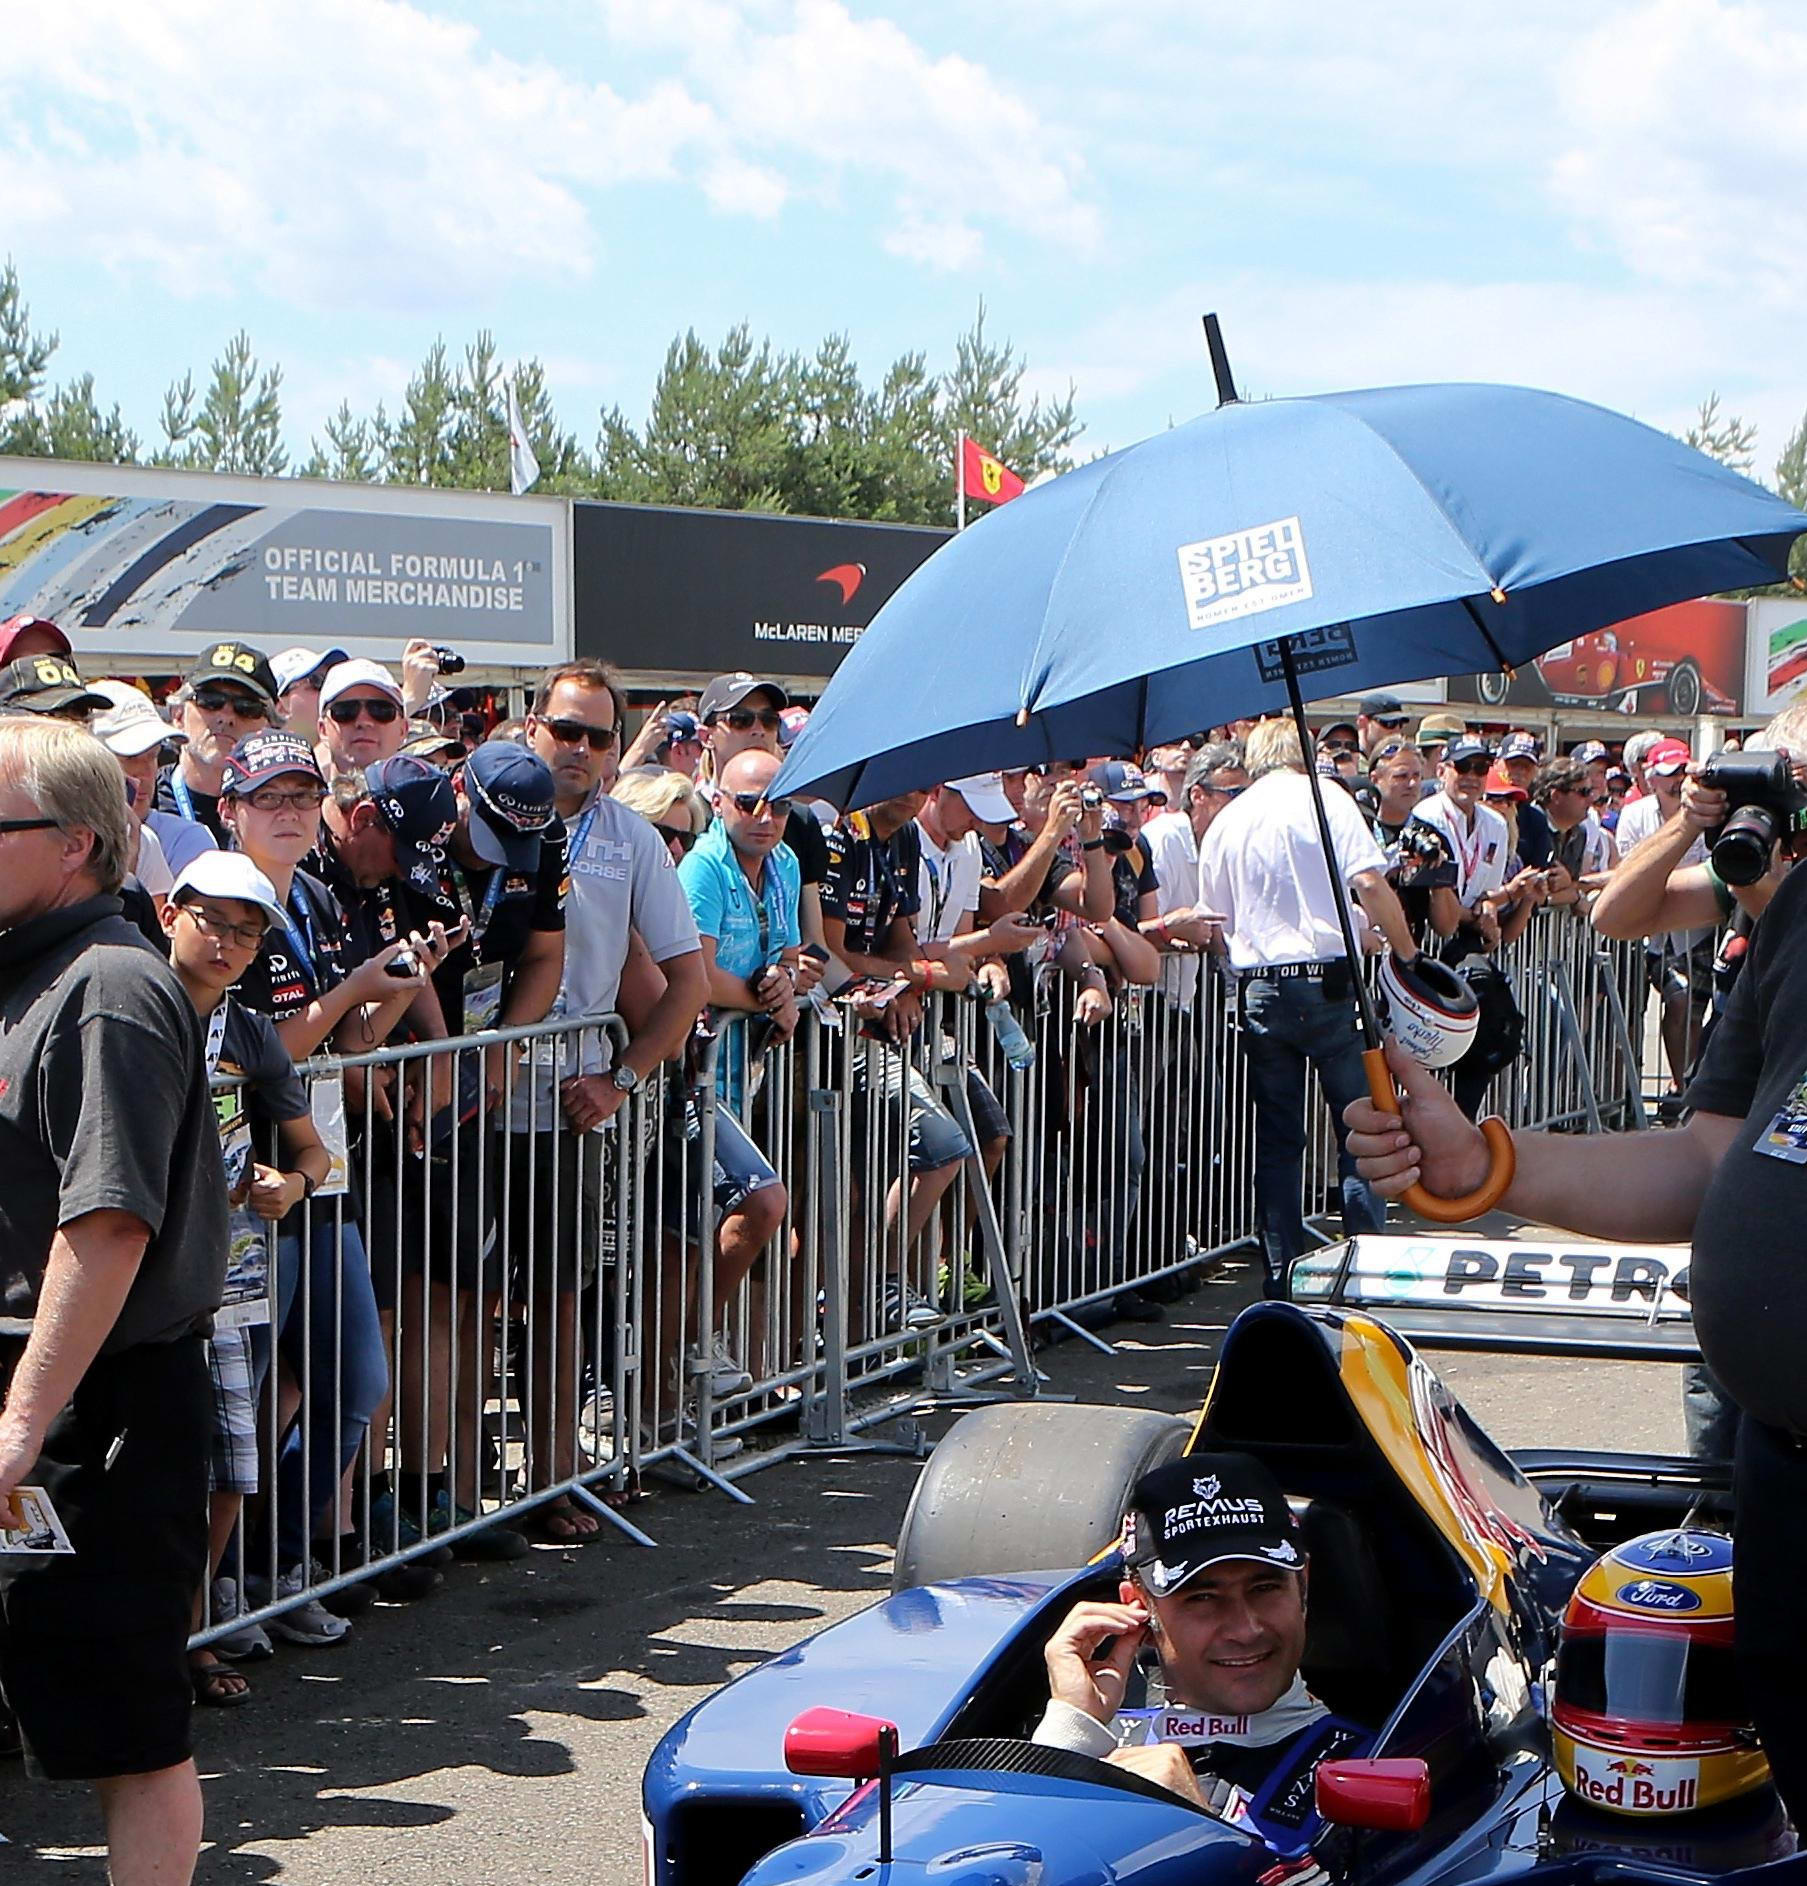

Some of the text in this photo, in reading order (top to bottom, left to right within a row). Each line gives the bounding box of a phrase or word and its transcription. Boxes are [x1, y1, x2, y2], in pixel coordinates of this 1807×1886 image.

[1187, 524, 1295, 574] SPIEL
[264, 546, 383, 576] OFFICIAL
[391, 553, 505, 582] FORMULA
[1189, 550, 1293, 601] BERG
[265, 575, 524, 611] TEAM MERCHANDISE
[755, 622, 828, 642] McLAREN
[36, 664, 81, 687] 04
[211, 651, 257, 674] 04
[272, 990, 304, 1003] OTAL
[1165, 1499, 1264, 1527] REMUS
[1164, 1514, 1265, 1540] SPORTEXHAUST
[1630, 1582, 1685, 1607] Ford
[1165, 1716, 1249, 1737] Red Bull
[1576, 1763, 1696, 1810] Red Bull
